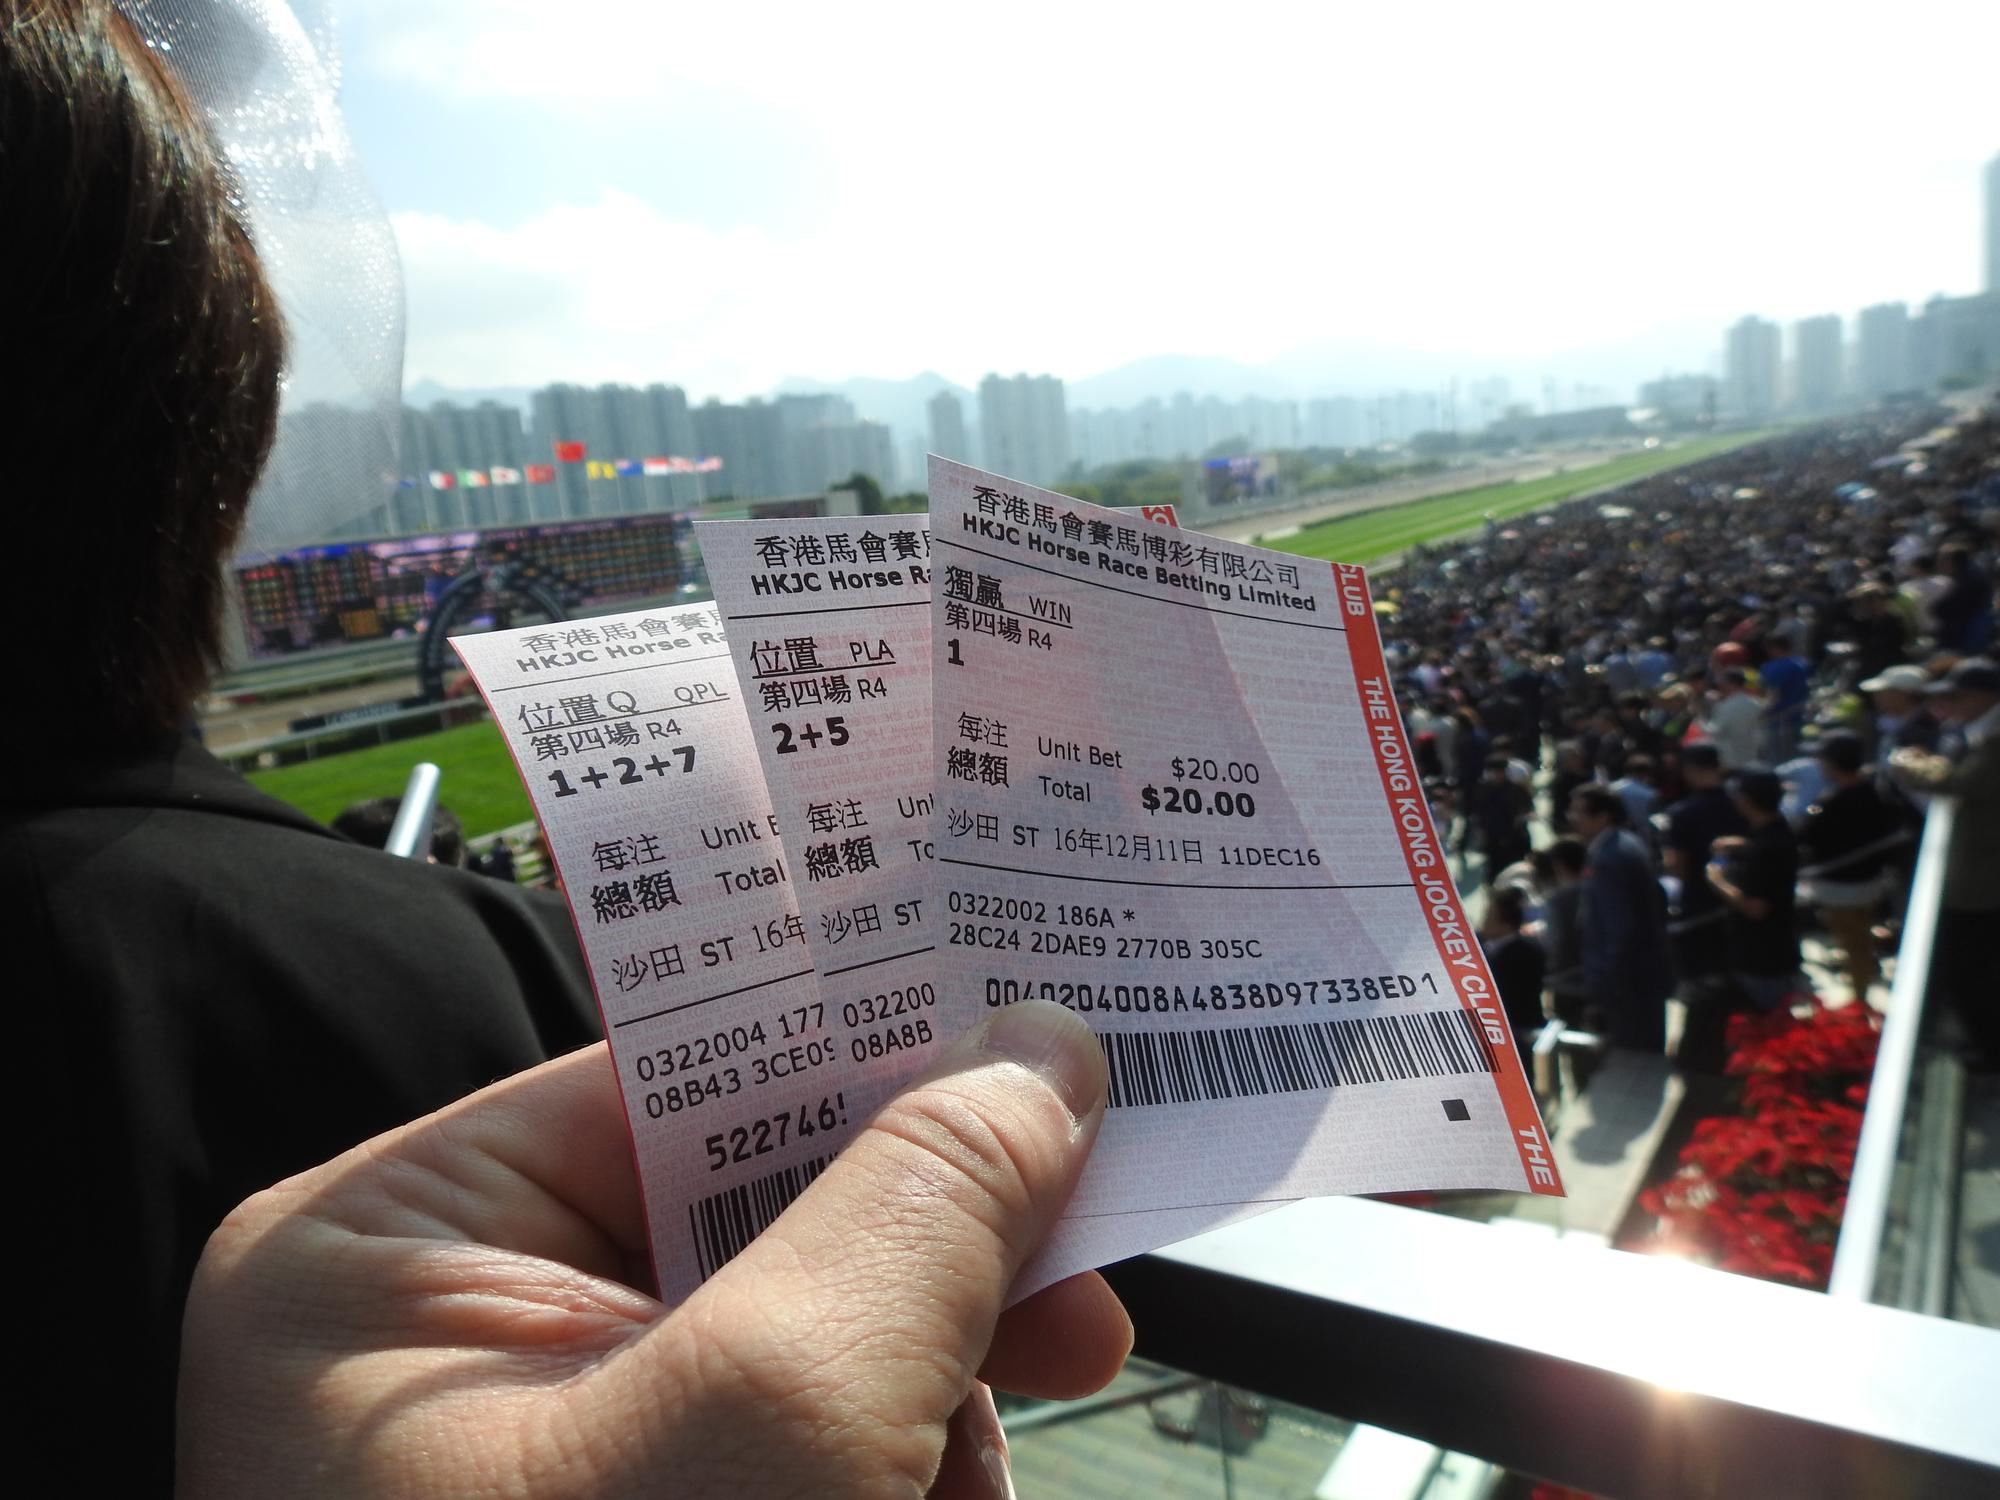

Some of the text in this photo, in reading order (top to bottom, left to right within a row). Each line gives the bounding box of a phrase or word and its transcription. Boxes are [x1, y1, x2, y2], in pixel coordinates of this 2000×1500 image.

[753, 530, 931, 569] 香港馬會賽
[963, 512, 1317, 612] HKJC Horse Race Betting Limited
[973, 485, 1300, 590] 香港馬會賽馬博彩有限公司
[750, 572, 822, 596] HKJC
[828, 569, 904, 591] Horse
[944, 565, 1072, 624] 獨贏 WIN
[944, 600, 1053, 651] 第四場 R4
[515, 648, 599, 673] HKJC
[608, 636, 692, 660] Horse
[749, 636, 895, 676] 位置 PLA
[947, 638, 965, 666] 1
[674, 680, 729, 705] QPL
[758, 674, 888, 713] 第四場 R4
[1362, 676, 1392, 720] THE
[530, 718, 683, 762] 第四場 R4
[771, 716, 850, 755] 2+5
[957, 711, 1260, 785] 每注 Unit Bet $20.00
[1374, 725, 1412, 793] HONG
[547, 745, 697, 798] 1+2+7
[946, 745, 1256, 818] 總額 Total $20.00
[805, 798, 869, 834] 每注
[948, 807, 1321, 867] 沙田 ST 16年12月11日 11DEC16
[1395, 797, 1436, 868] KONG
[591, 833, 667, 873] 每注
[700, 819, 762, 850] Unit
[803, 834, 880, 883] 總額
[589, 857, 787, 925] 總額 Total
[948, 890, 1048, 924] 0322002
[1058, 905, 1116, 929] 186A
[820, 899, 922, 945] 沙田 ST
[948, 922, 1263, 960] 28C24 2DAE9 2770B 305C
[1419, 872, 1478, 970] JOCKEY
[611, 913, 807, 993] 沙田 ST 16年
[842, 982, 936, 1028] 032200
[1460, 974, 1506, 1046] CLUB
[636, 1002, 825, 1082] 0322004 177
[851, 1019, 933, 1063] 08A8B
[645, 1067, 742, 1120] 08B43
[1518, 1125, 1555, 1188] THE
